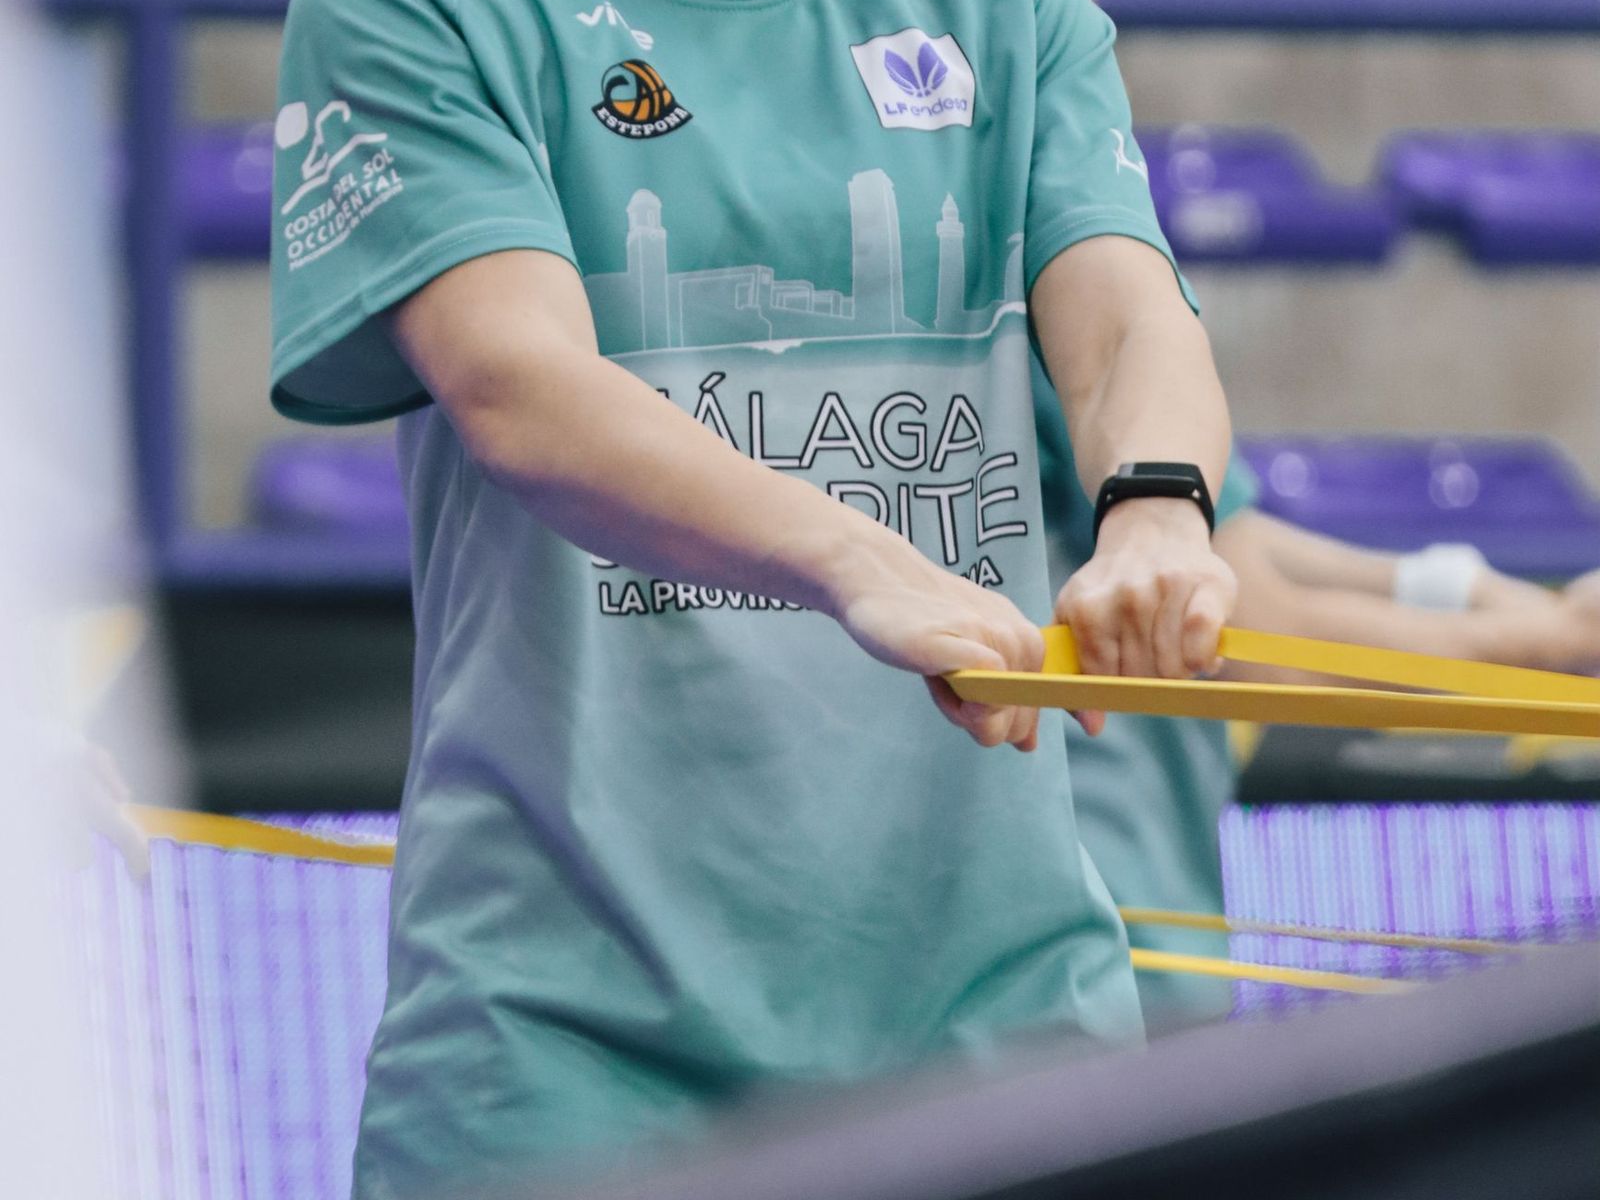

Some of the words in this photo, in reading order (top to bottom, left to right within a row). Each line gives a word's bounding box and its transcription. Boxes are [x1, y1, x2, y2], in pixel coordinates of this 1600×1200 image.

[576, 0, 654, 51] vie
[596, 105, 689, 137] ESTEPONA
[284, 197, 337, 240] COSTA
[332, 172, 358, 201] DEL
[362, 147, 394, 180] SOL
[287, 168, 402, 260] OCCIDENTAL
[656, 371, 985, 472] ÁLAGA
[598, 581, 648, 616] LA
